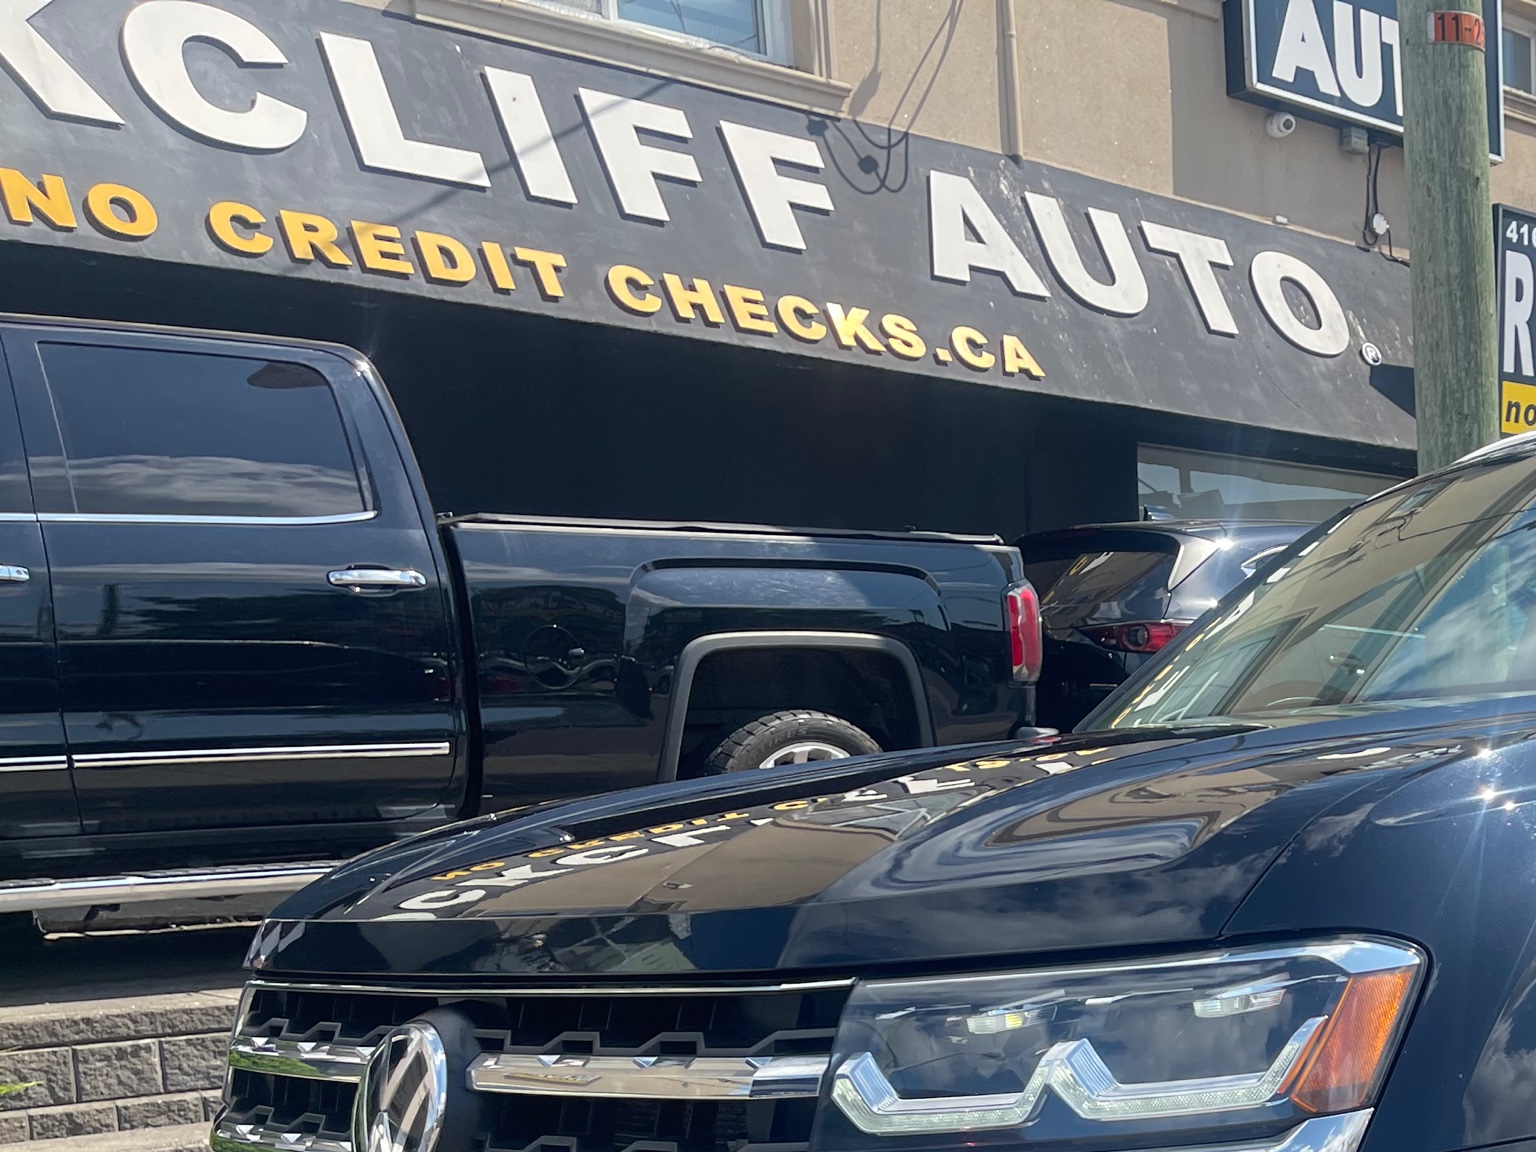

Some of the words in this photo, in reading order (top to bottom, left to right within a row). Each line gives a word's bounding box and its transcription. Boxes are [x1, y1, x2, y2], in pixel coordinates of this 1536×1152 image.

[0, 167, 159, 239] NO
[207, 200, 569, 298] CREDIT
[606, 263, 1046, 379] CHECKS.CA
[929, 169, 1351, 357] AUTO
